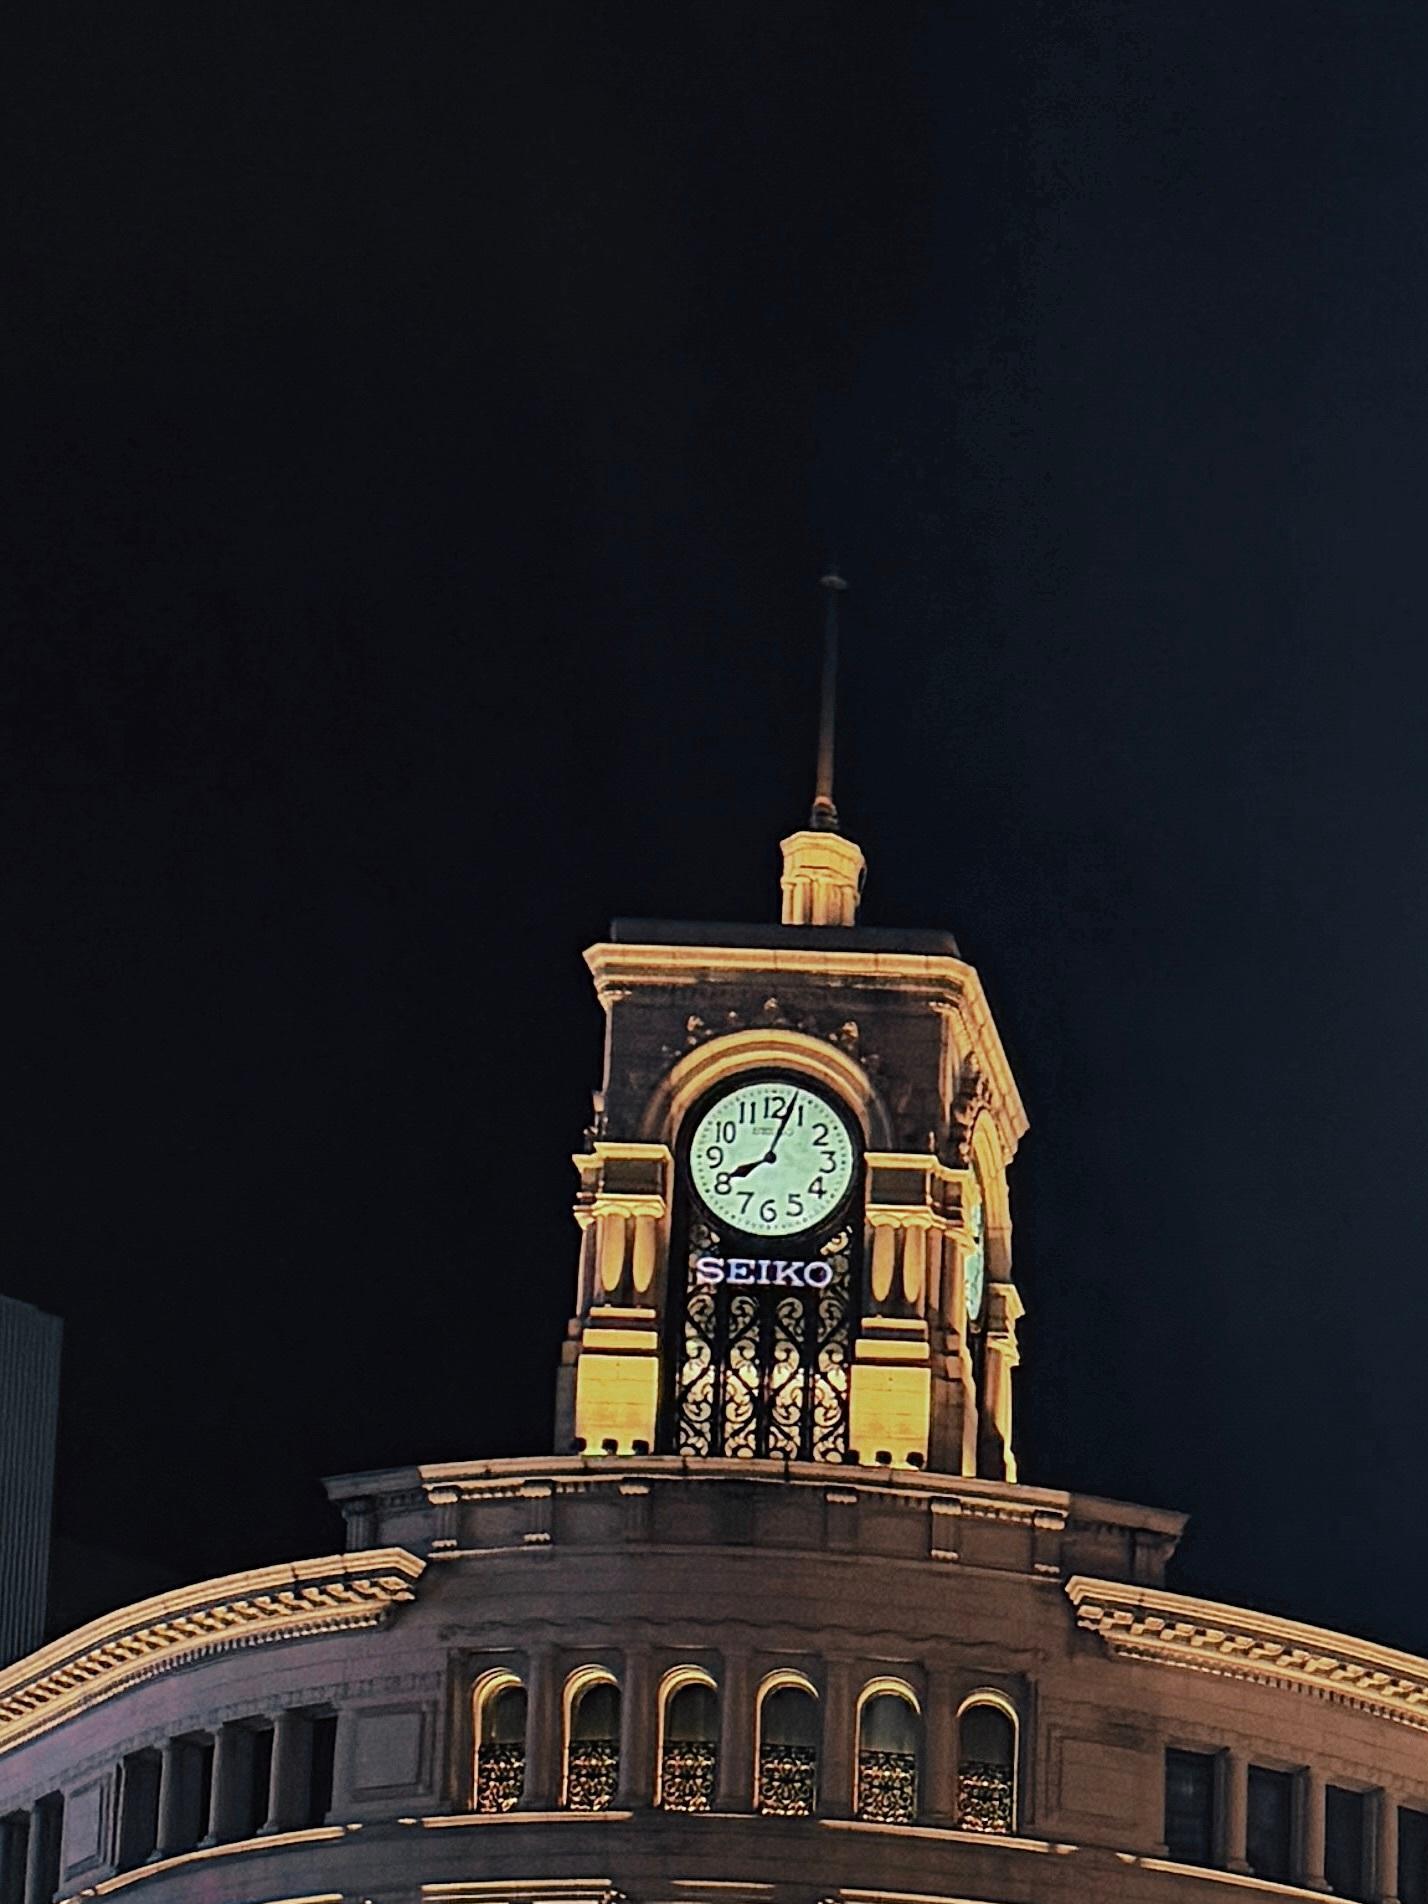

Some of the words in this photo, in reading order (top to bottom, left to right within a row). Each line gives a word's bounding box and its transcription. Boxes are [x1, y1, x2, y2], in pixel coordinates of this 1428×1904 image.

[739, 1101, 756, 1124] 11
[763, 1095, 787, 1120] 12
[797, 1104, 804, 1127] 1
[715, 1120, 737, 1144] 10
[812, 1122, 830, 1147] 2
[705, 1145, 725, 1169] 9
[819, 1150, 837, 1174] 3
[714, 1171, 733, 1195] 8
[807, 1175, 827, 1200] 4
[736, 1191, 755, 1215] 7
[759, 1199, 778, 1223] 6
[786, 1193, 805, 1217] 5
[695, 1255, 834, 1289] SEIKO
